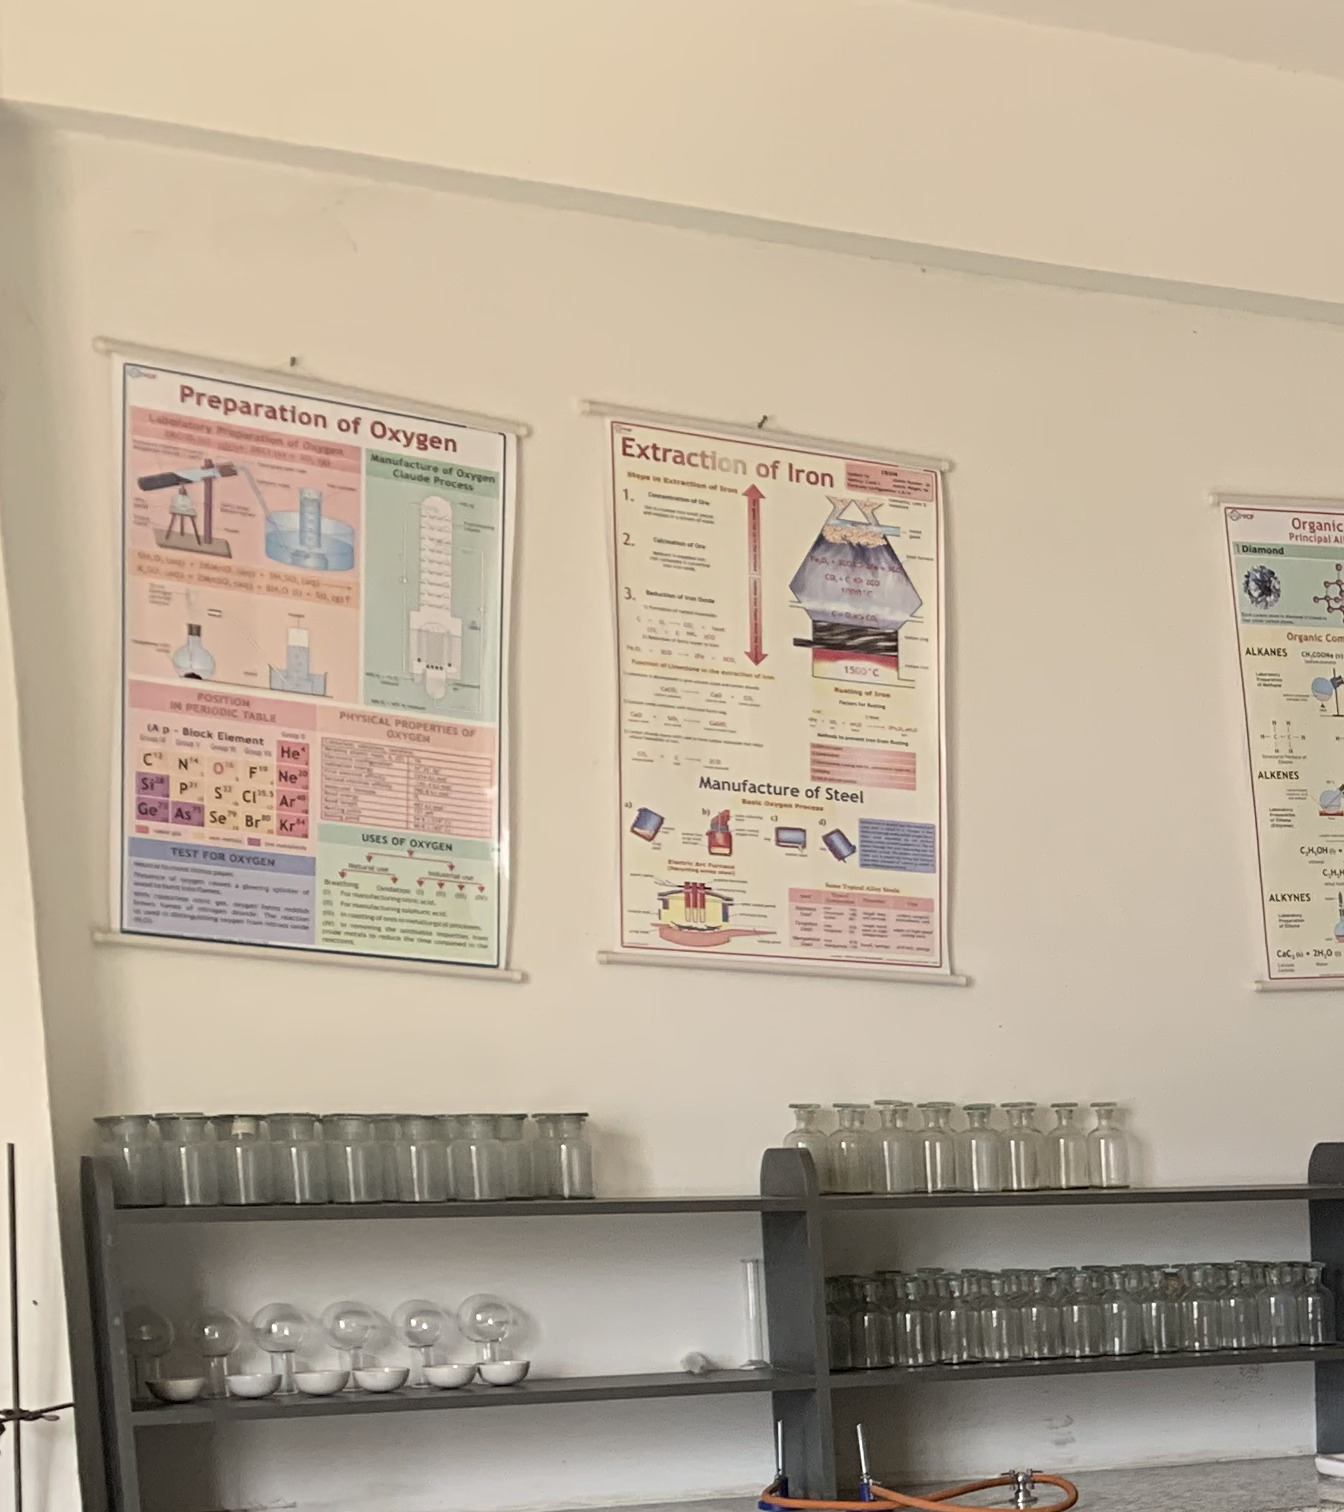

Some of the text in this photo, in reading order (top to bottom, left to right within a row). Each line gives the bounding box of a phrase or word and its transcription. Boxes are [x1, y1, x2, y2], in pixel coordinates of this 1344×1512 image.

[180, 385, 457, 453] Preparation of Oxygen
[149, 414, 344, 456] Laboratory Preparation of Oxygen
[371, 454, 496, 484] Manufacture of Oxygen
[621, 436, 747, 476] Extraction
[756, 461, 781, 481] of
[789, 462, 834, 488] Iron
[393, 470, 474, 492] Claude Process
[663, 477, 706, 489] Extraction
[720, 486, 738, 494] Iron
[1292, 518, 1344, 534] Organic
[1289, 533, 1331, 544] Principal
[1242, 545, 1284, 555] Diamond
[1287, 632, 1323, 644] Organic
[1245, 647, 1287, 657] ALKANES
[834, 687, 862, 696] Rusting
[197, 693, 250, 707] POSITION
[170, 701, 276, 723] IN PERIODIC TABLE
[340, 712, 476, 737] PHYSICAL PROPERTIES OF
[183, 728, 213, 739] Block
[218, 732, 264, 745] Element
[387, 730, 430, 743] OXYGEN
[1258, 771, 1300, 780] ALKENES
[699, 777, 864, 803] Manufacture of Steel
[702, 808, 710, 816] b)
[742, 799, 824, 812] Basic Oxygen Process
[819, 818, 826, 826] d)
[362, 834, 452, 851] USES OF OXYGEN
[171, 847, 275, 867] TEST FOR OXYGEN
[1269, 893, 1311, 902] ALKYNES
